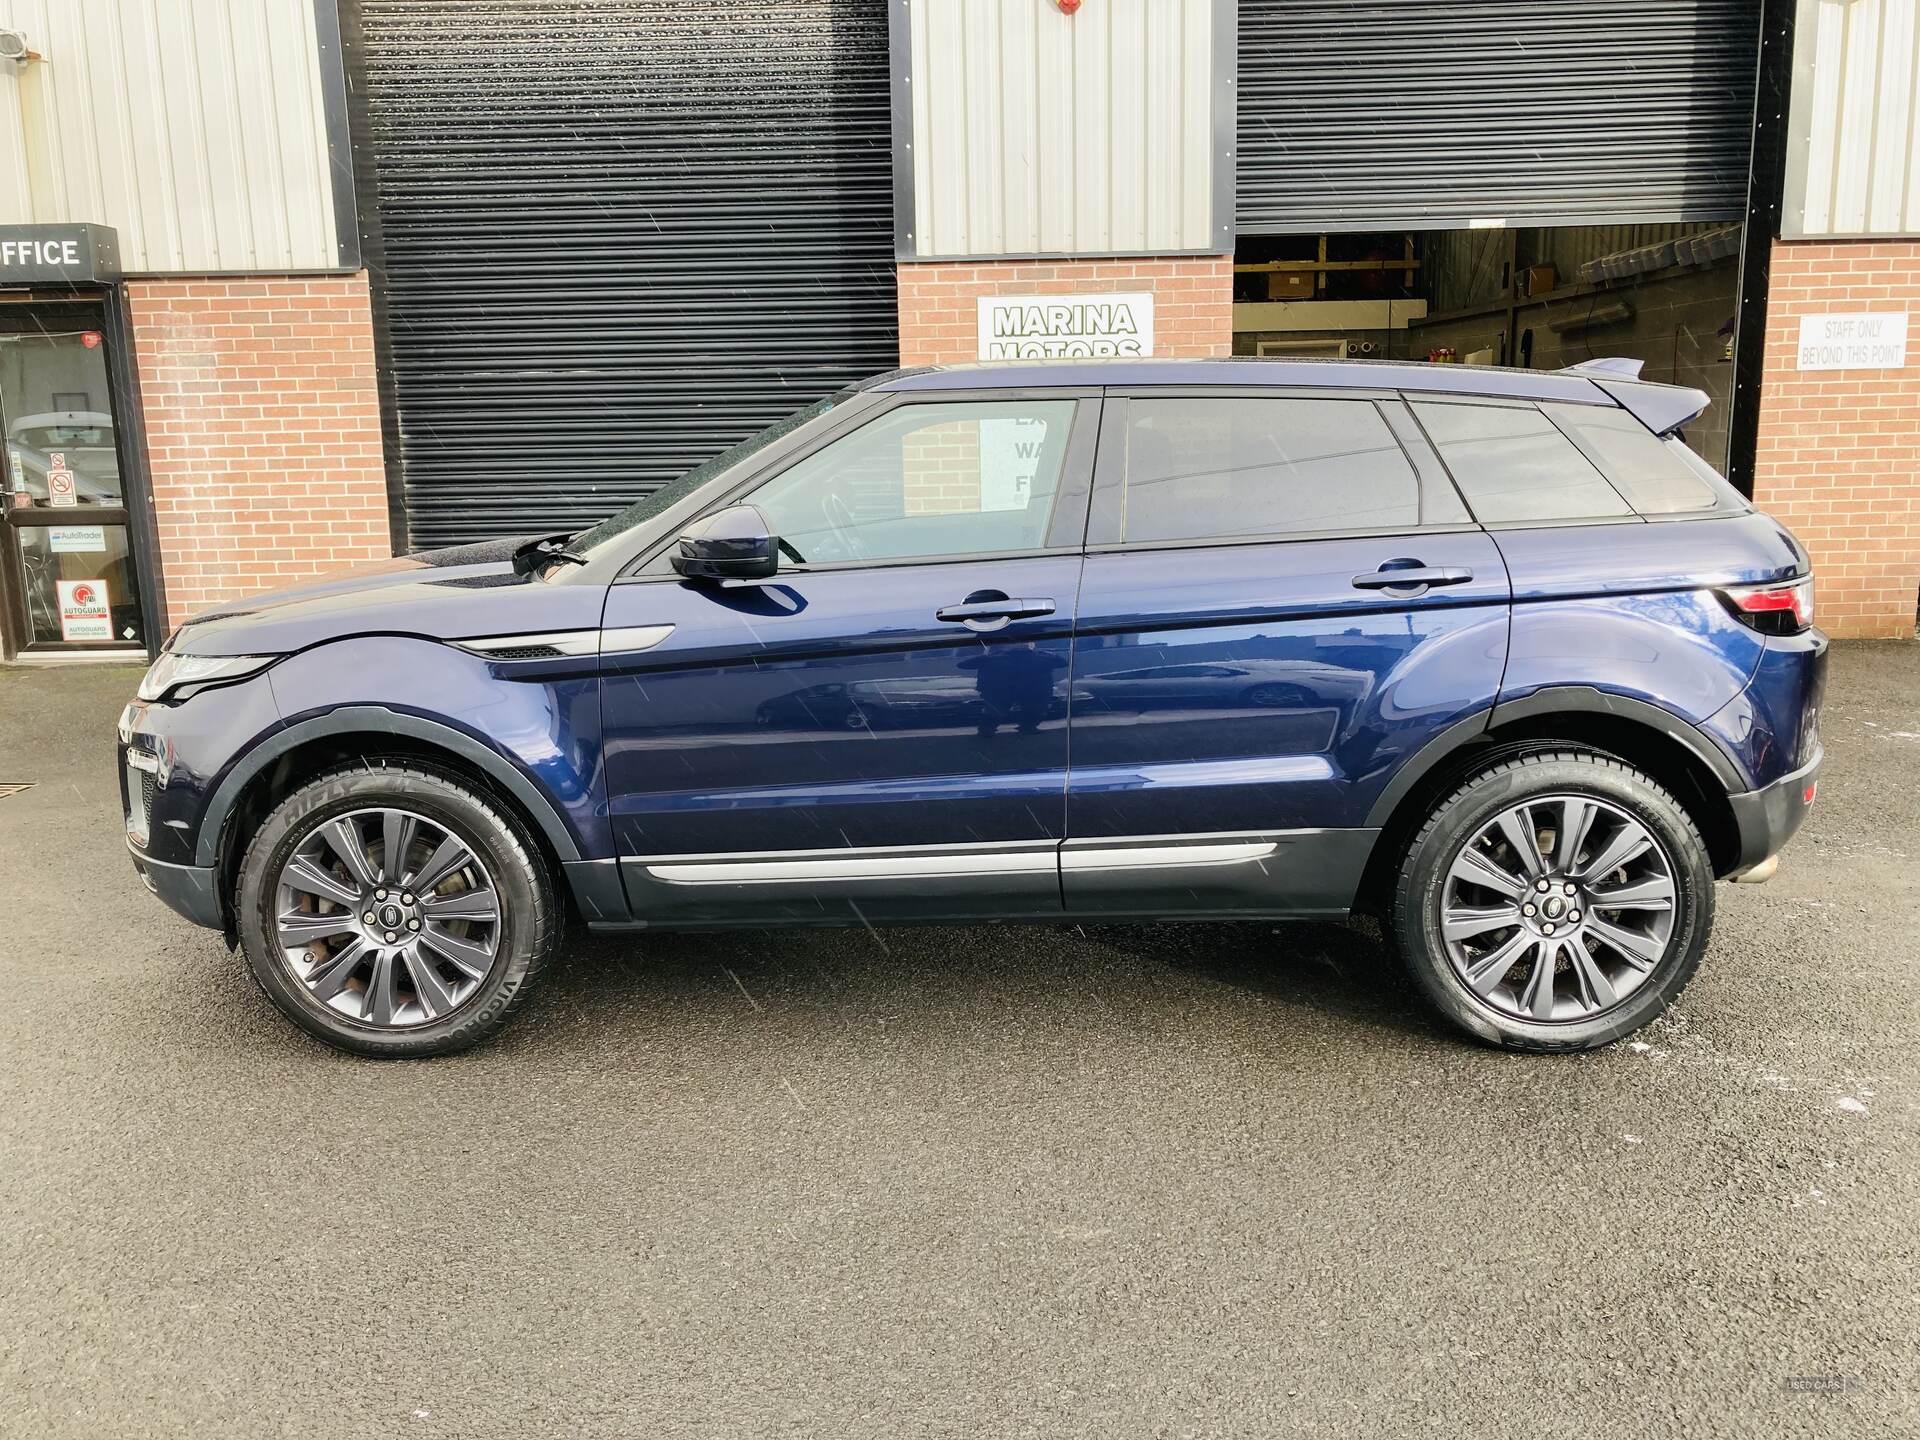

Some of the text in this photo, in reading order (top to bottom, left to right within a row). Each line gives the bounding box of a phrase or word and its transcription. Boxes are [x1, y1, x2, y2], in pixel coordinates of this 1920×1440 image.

[0, 240, 80, 265] FFICE
[993, 304, 1138, 337] MARINA
[1824, 319, 1883, 339] STAFF ONLY
[1802, 345, 1901, 365] BEYOND THIS POINT
